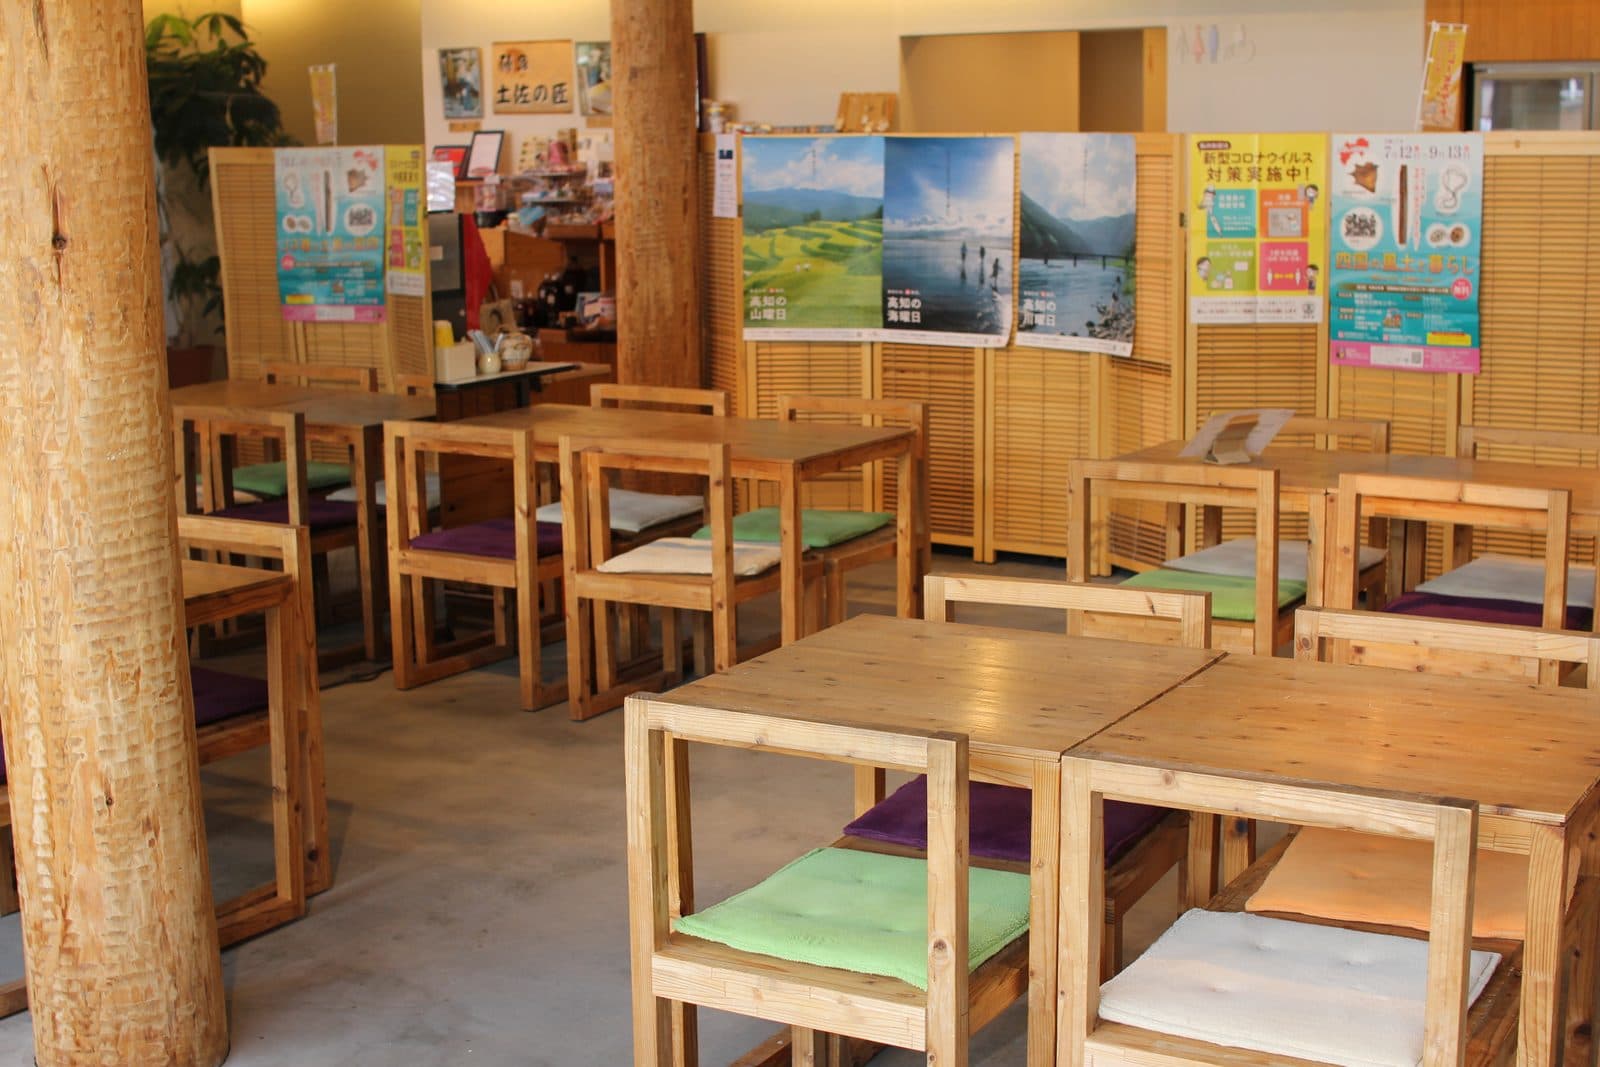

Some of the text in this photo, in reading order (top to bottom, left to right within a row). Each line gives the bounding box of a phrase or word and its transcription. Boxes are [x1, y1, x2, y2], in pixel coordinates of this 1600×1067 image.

[496, 82, 568, 104] 土佐の匠
[1203, 152, 1313, 165] 新型コロナウイルス
[750, 296, 787, 307] 高知の
[887, 297, 922, 309] 高知の
[750, 308, 787, 321] 山曜日
[887, 310, 921, 323] 海曜日
